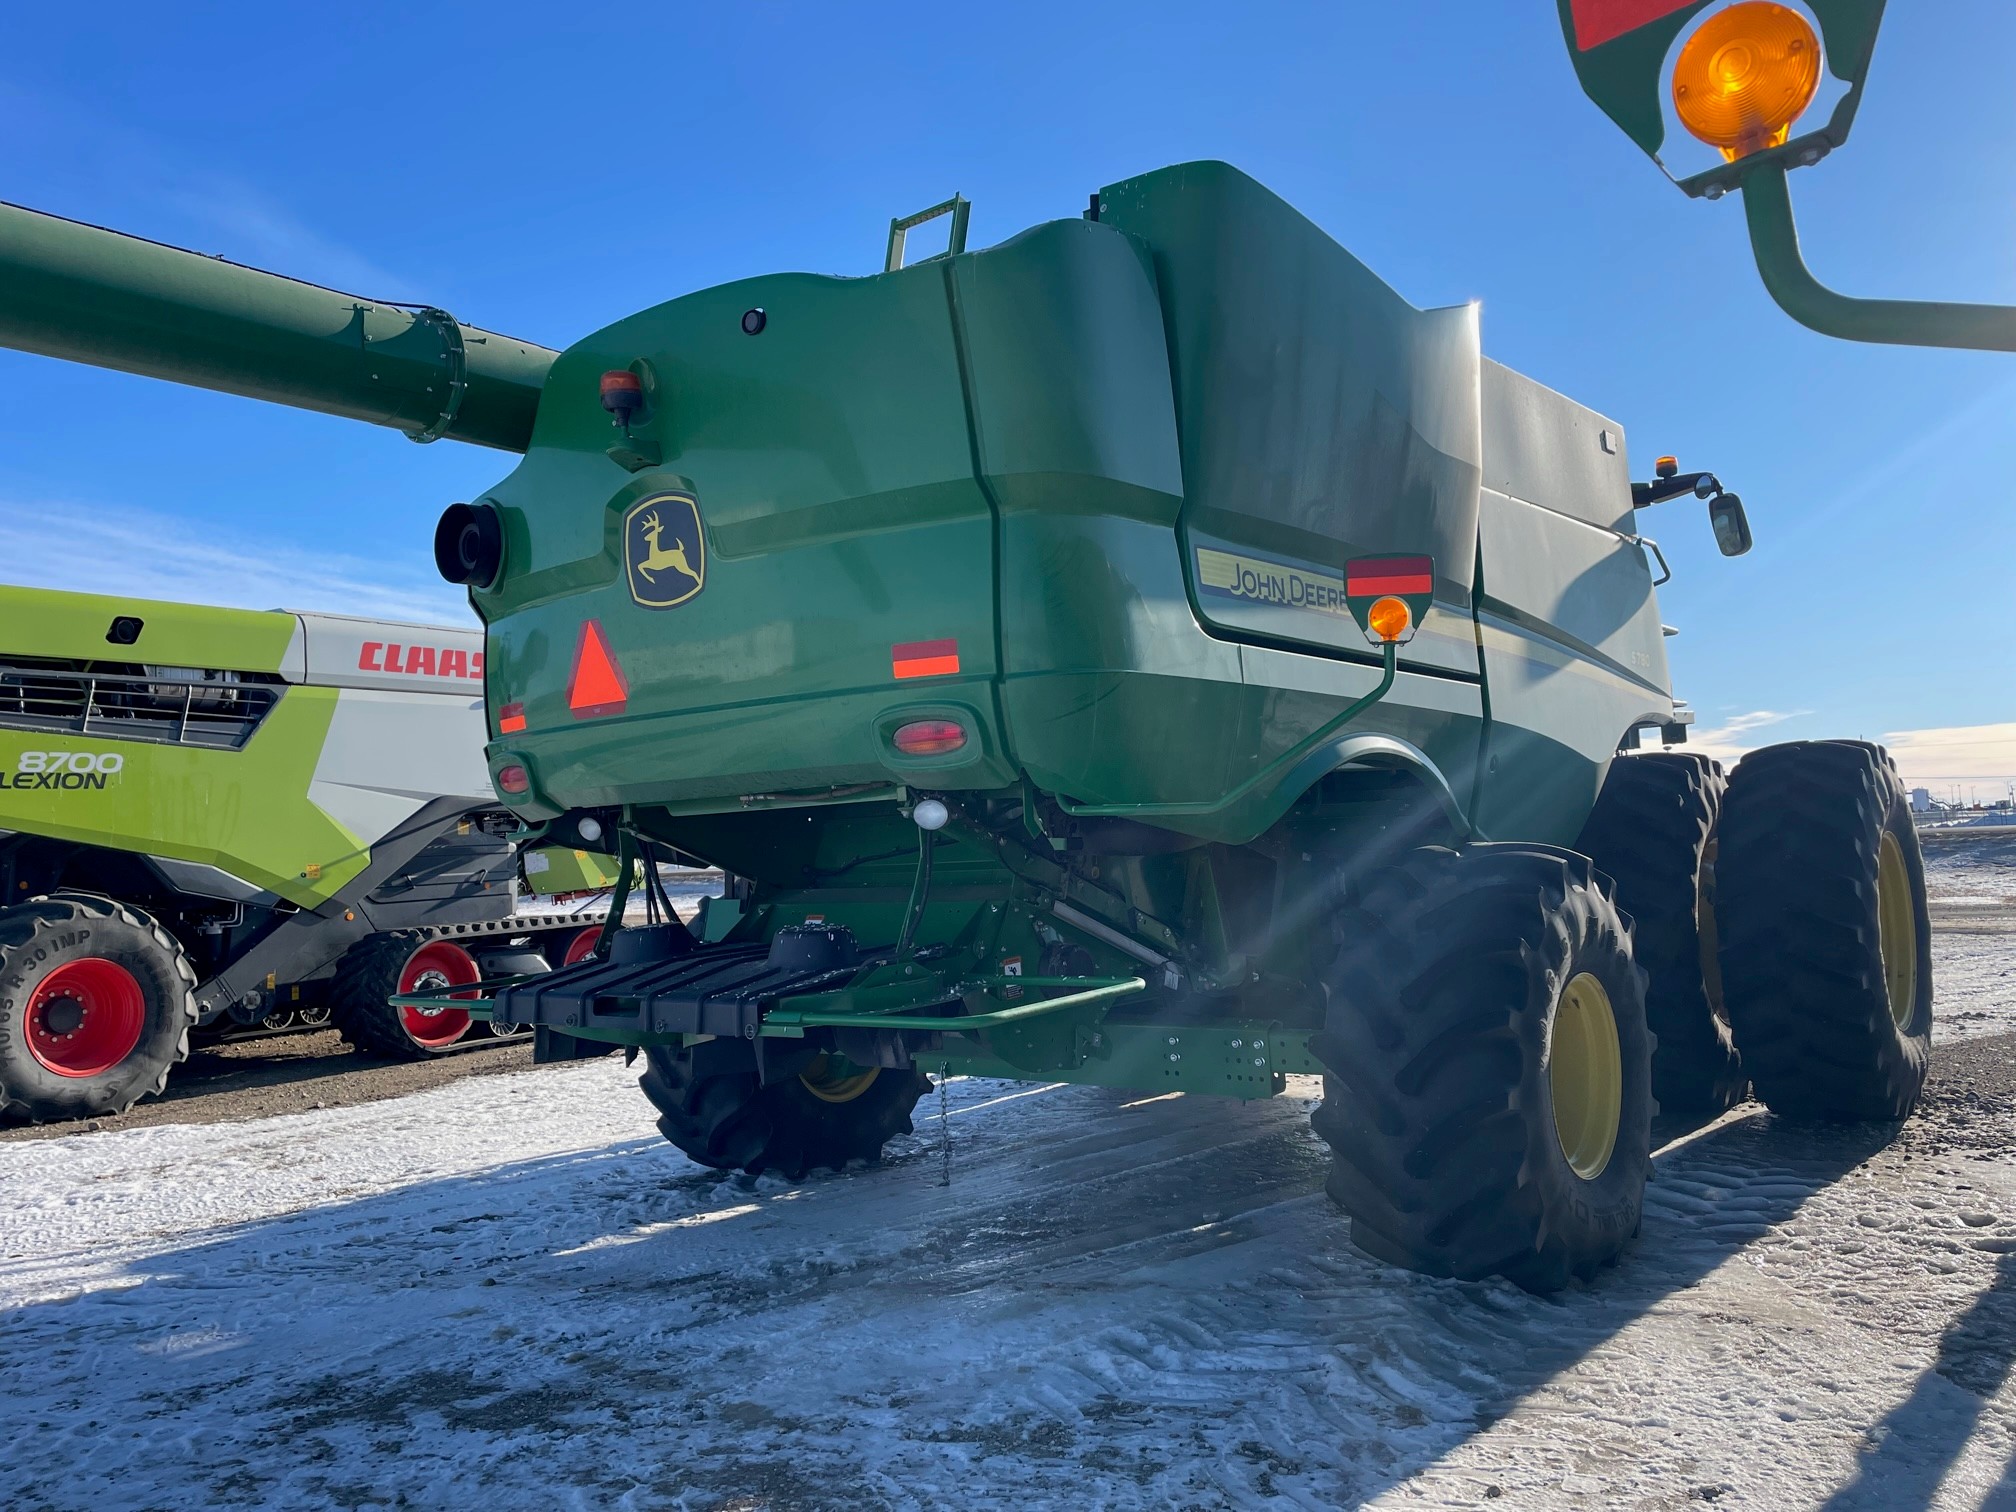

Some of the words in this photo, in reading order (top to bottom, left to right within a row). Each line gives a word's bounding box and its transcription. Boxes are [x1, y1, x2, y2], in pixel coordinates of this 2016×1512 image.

[1230, 563, 1286, 600] JOHN
[1289, 575, 1347, 609] DEERE
[358, 641, 483, 679] CLAAS
[0, 772, 107, 789] LEXION
[17, 751, 124, 774] 8700
[23, 948, 47, 971] 30
[50, 930, 90, 952] IMP
